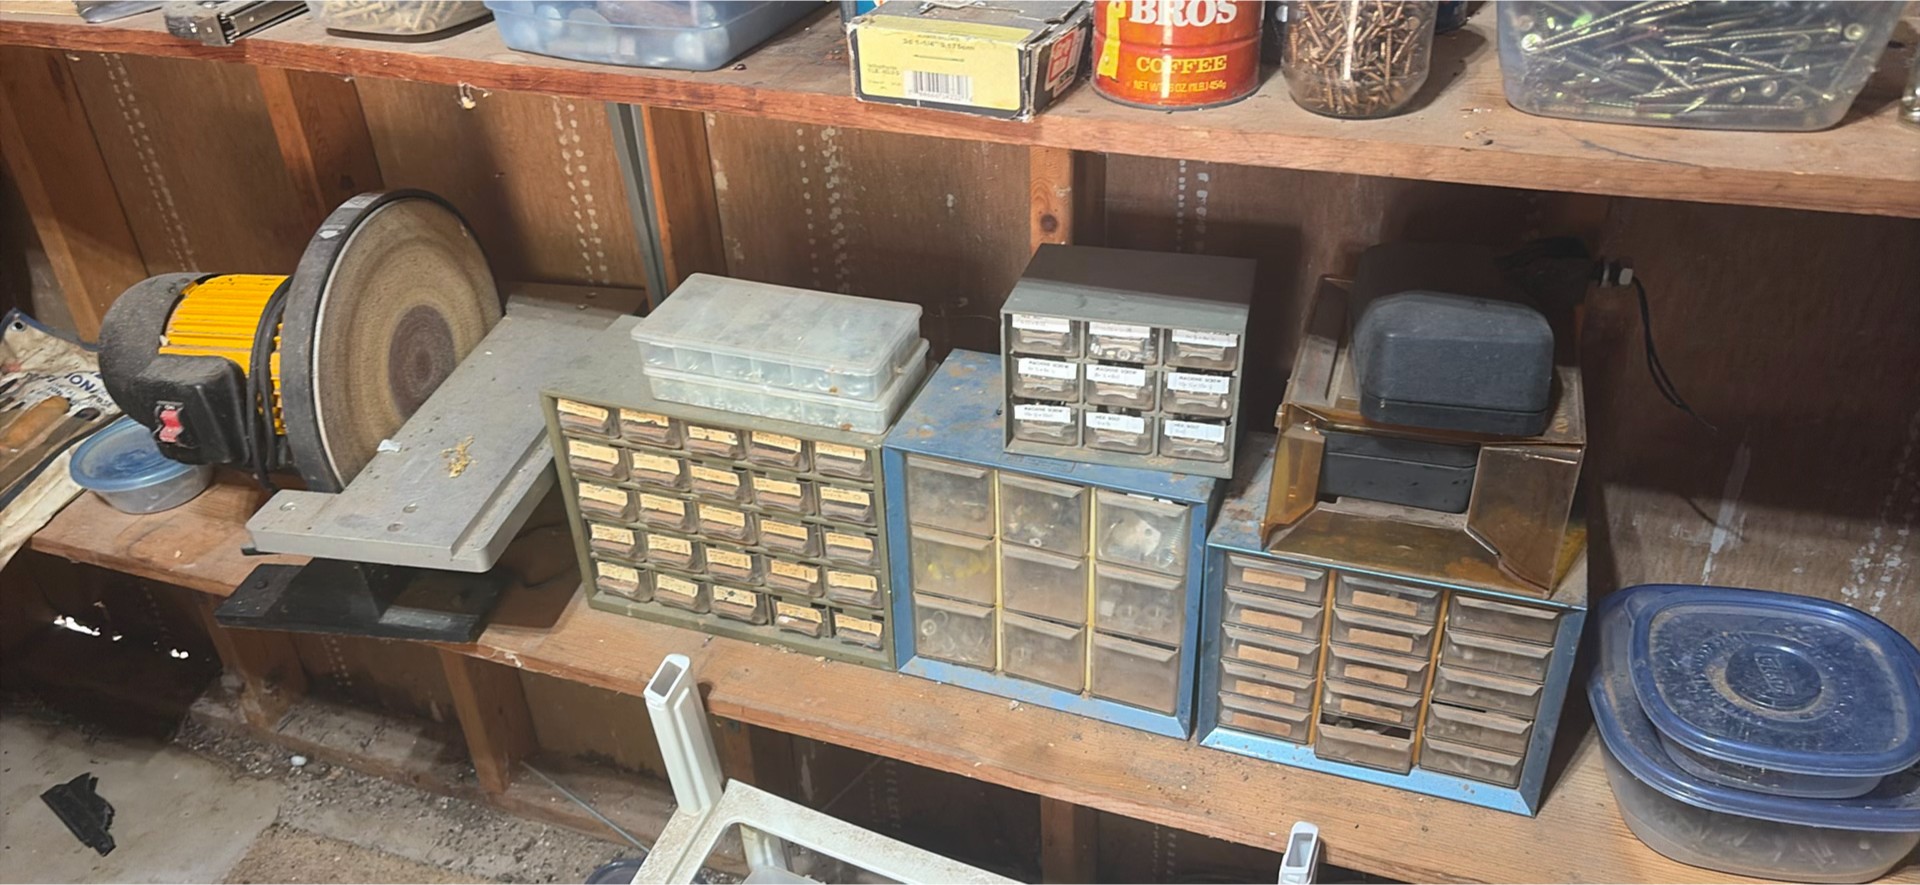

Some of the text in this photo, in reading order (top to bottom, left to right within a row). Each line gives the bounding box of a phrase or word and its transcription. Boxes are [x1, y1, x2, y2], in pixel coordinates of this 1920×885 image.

[1129, 0, 1237, 27] BROS
[1136, 55, 1228, 74] COFFEE
[1133, 79, 1148, 90] NET
